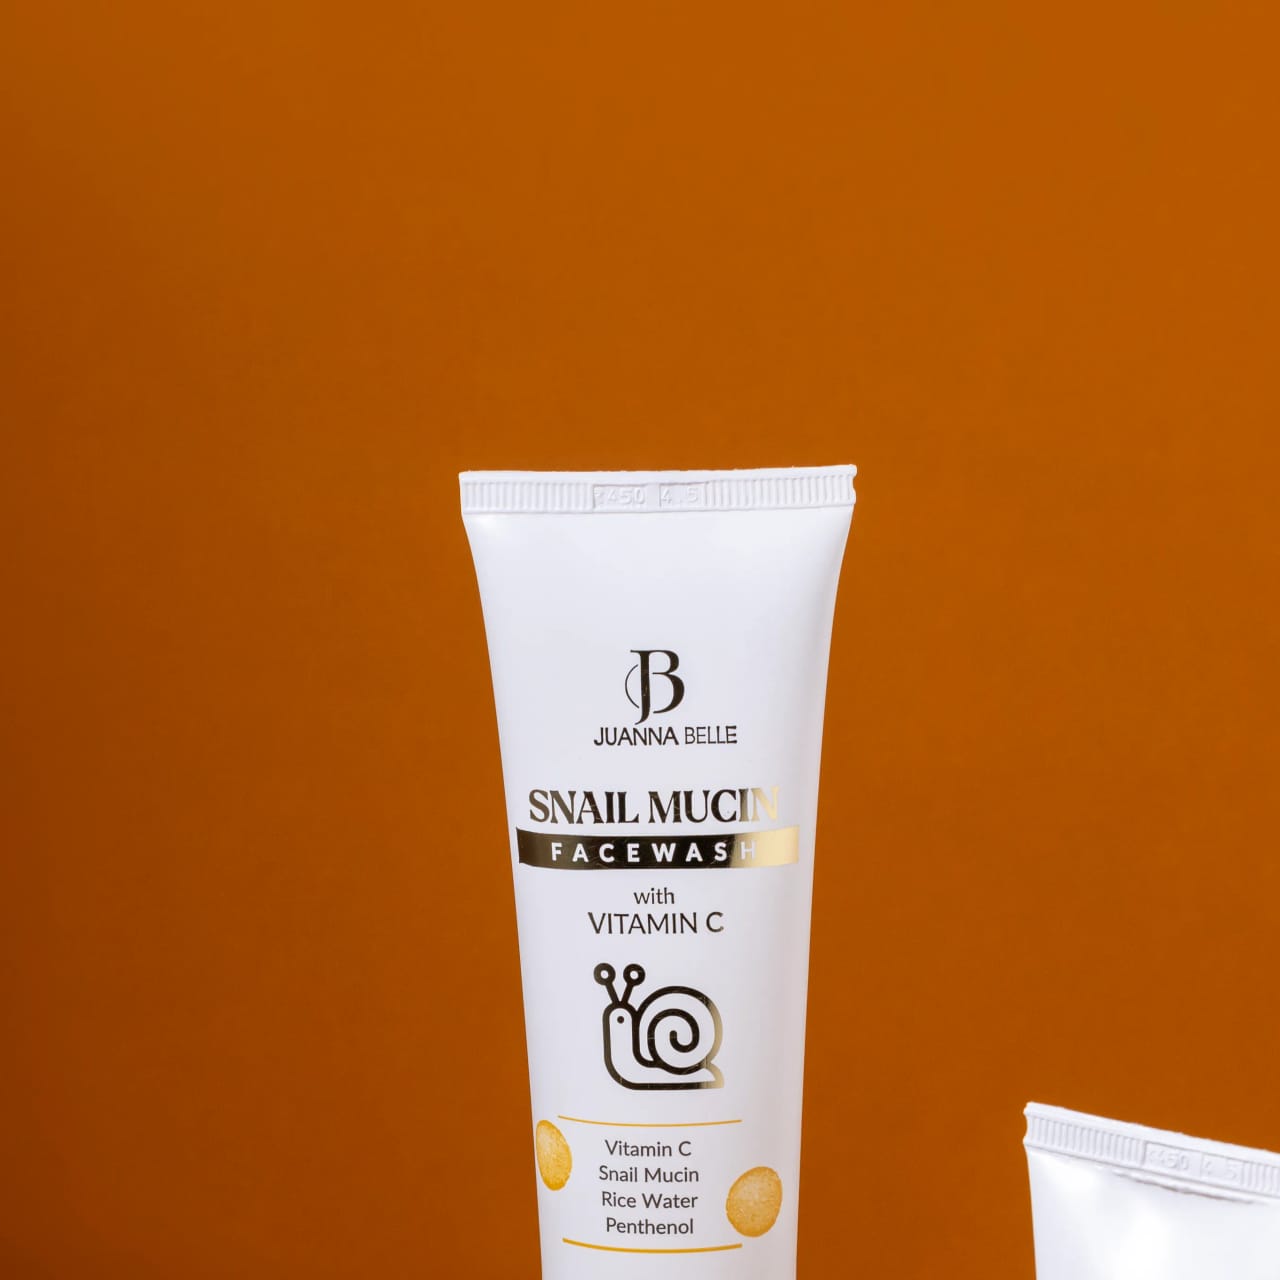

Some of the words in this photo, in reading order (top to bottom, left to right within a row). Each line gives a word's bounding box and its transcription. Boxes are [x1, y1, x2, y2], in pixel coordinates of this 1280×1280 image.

[593, 726, 680, 747] JUANNA
[684, 724, 738, 745] BELLE
[528, 788, 640, 825] SNAIL
[647, 785, 781, 825] MUCIN
[550, 837, 758, 864] FACEWASH
[632, 886, 676, 905] with
[587, 911, 698, 935] VITAMIN
[705, 911, 725, 934] C
[604, 1138, 673, 1158] Vitamin
[678, 1140, 692, 1157] C
[598, 1164, 639, 1183] Snail
[644, 1166, 700, 1184] Mucin
[601, 1190, 637, 1209] Rice
[641, 1192, 699, 1209] Water
[605, 1216, 694, 1236] Penthenol
